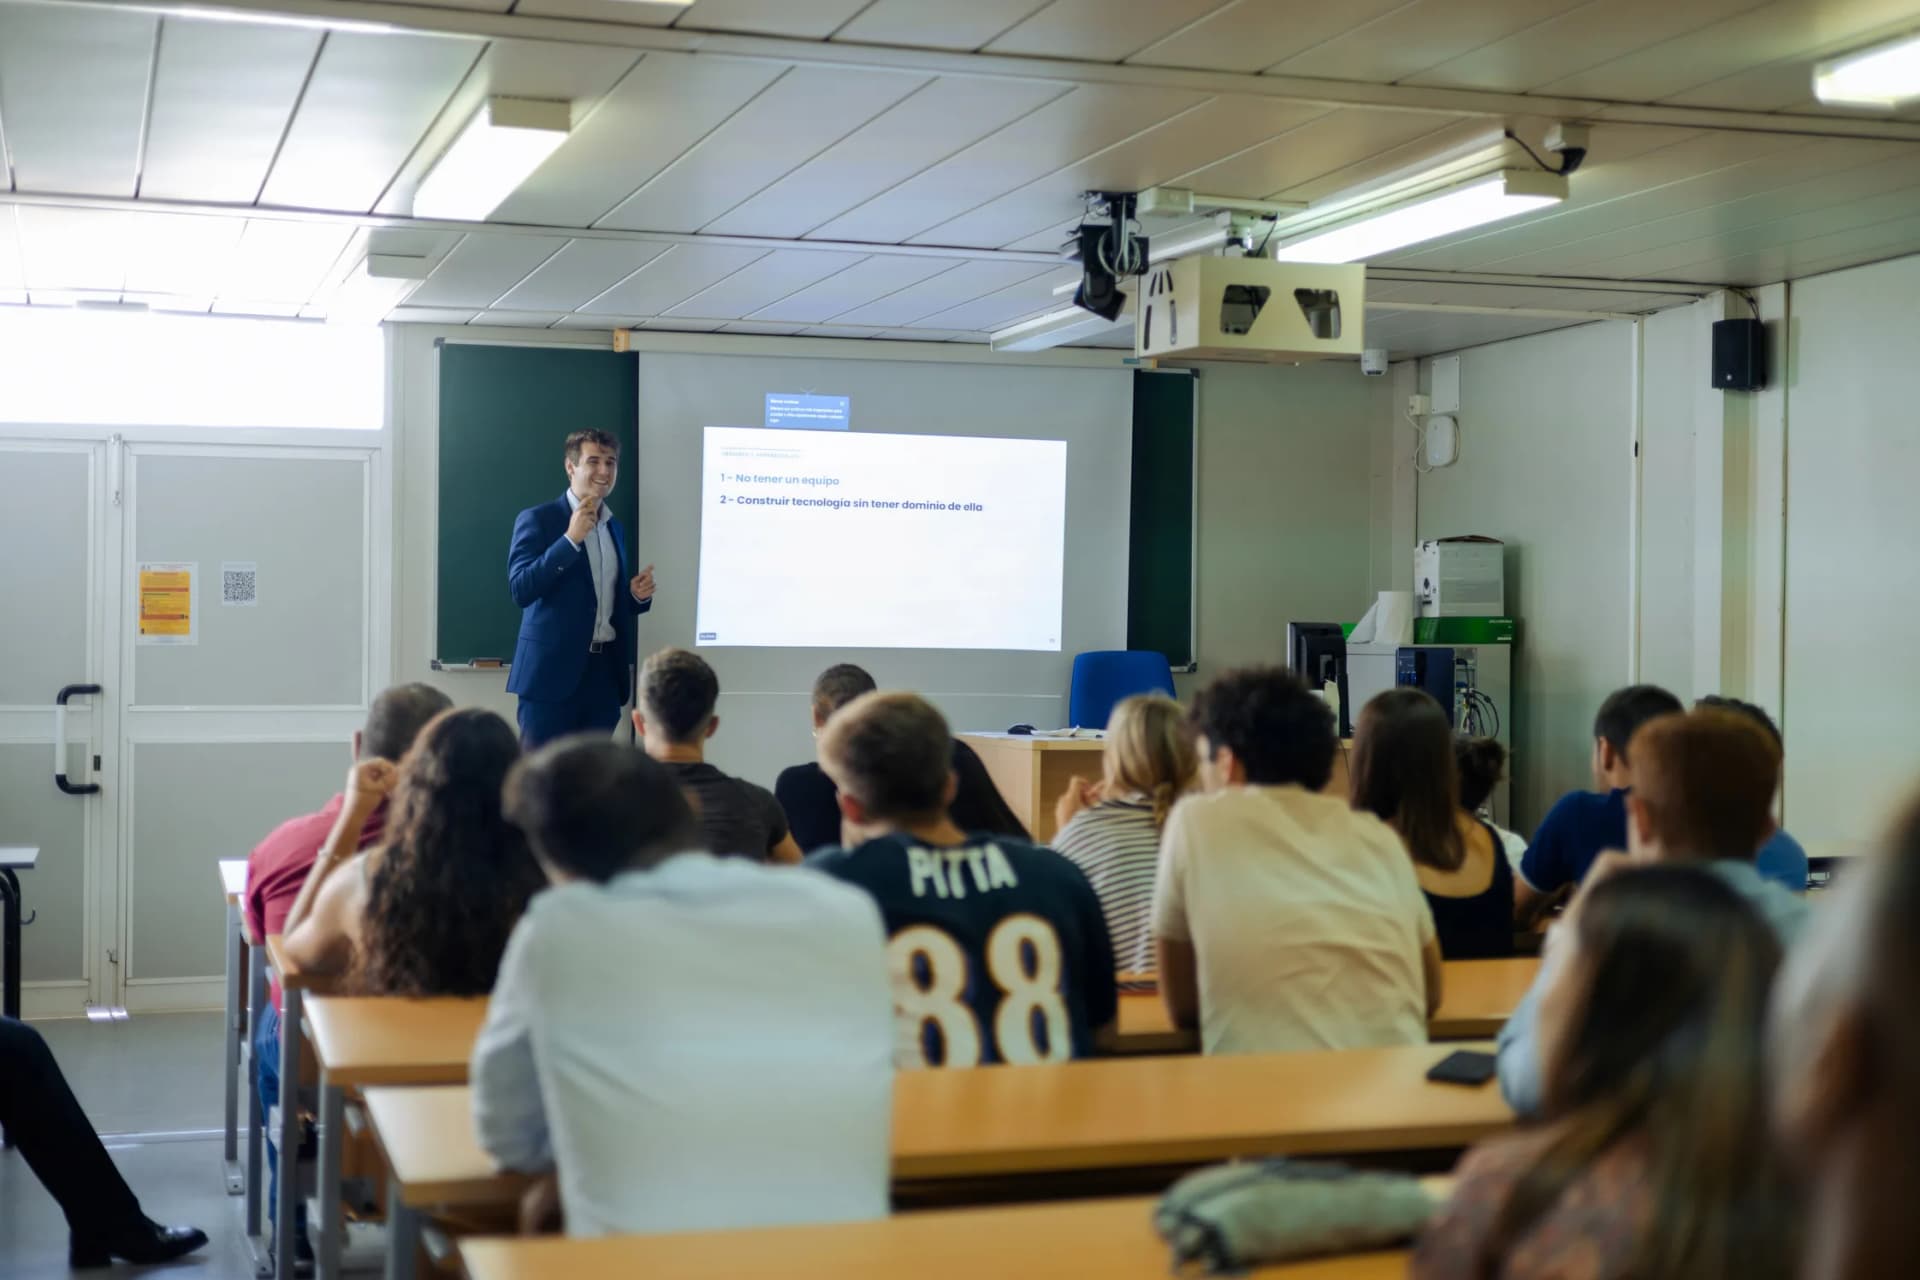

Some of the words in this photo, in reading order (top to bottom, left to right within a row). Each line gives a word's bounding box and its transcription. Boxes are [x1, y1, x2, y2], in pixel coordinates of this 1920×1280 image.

[720, 472, 726, 483] 1
[735, 473, 752, 483] No
[753, 474, 783, 485] tener
[786, 476, 800, 485] un
[802, 475, 840, 488] equipo
[720, 494, 727, 505] 2
[736, 495, 790, 506] Construir
[853, 497, 869, 508] sin
[871, 499, 900, 509] tener
[901, 499, 946, 511] dominio
[948, 501, 961, 511] de
[963, 502, 983, 512] ella
[906, 843, 1018, 899] PITTA
[887, 913, 1072, 1067] 88
